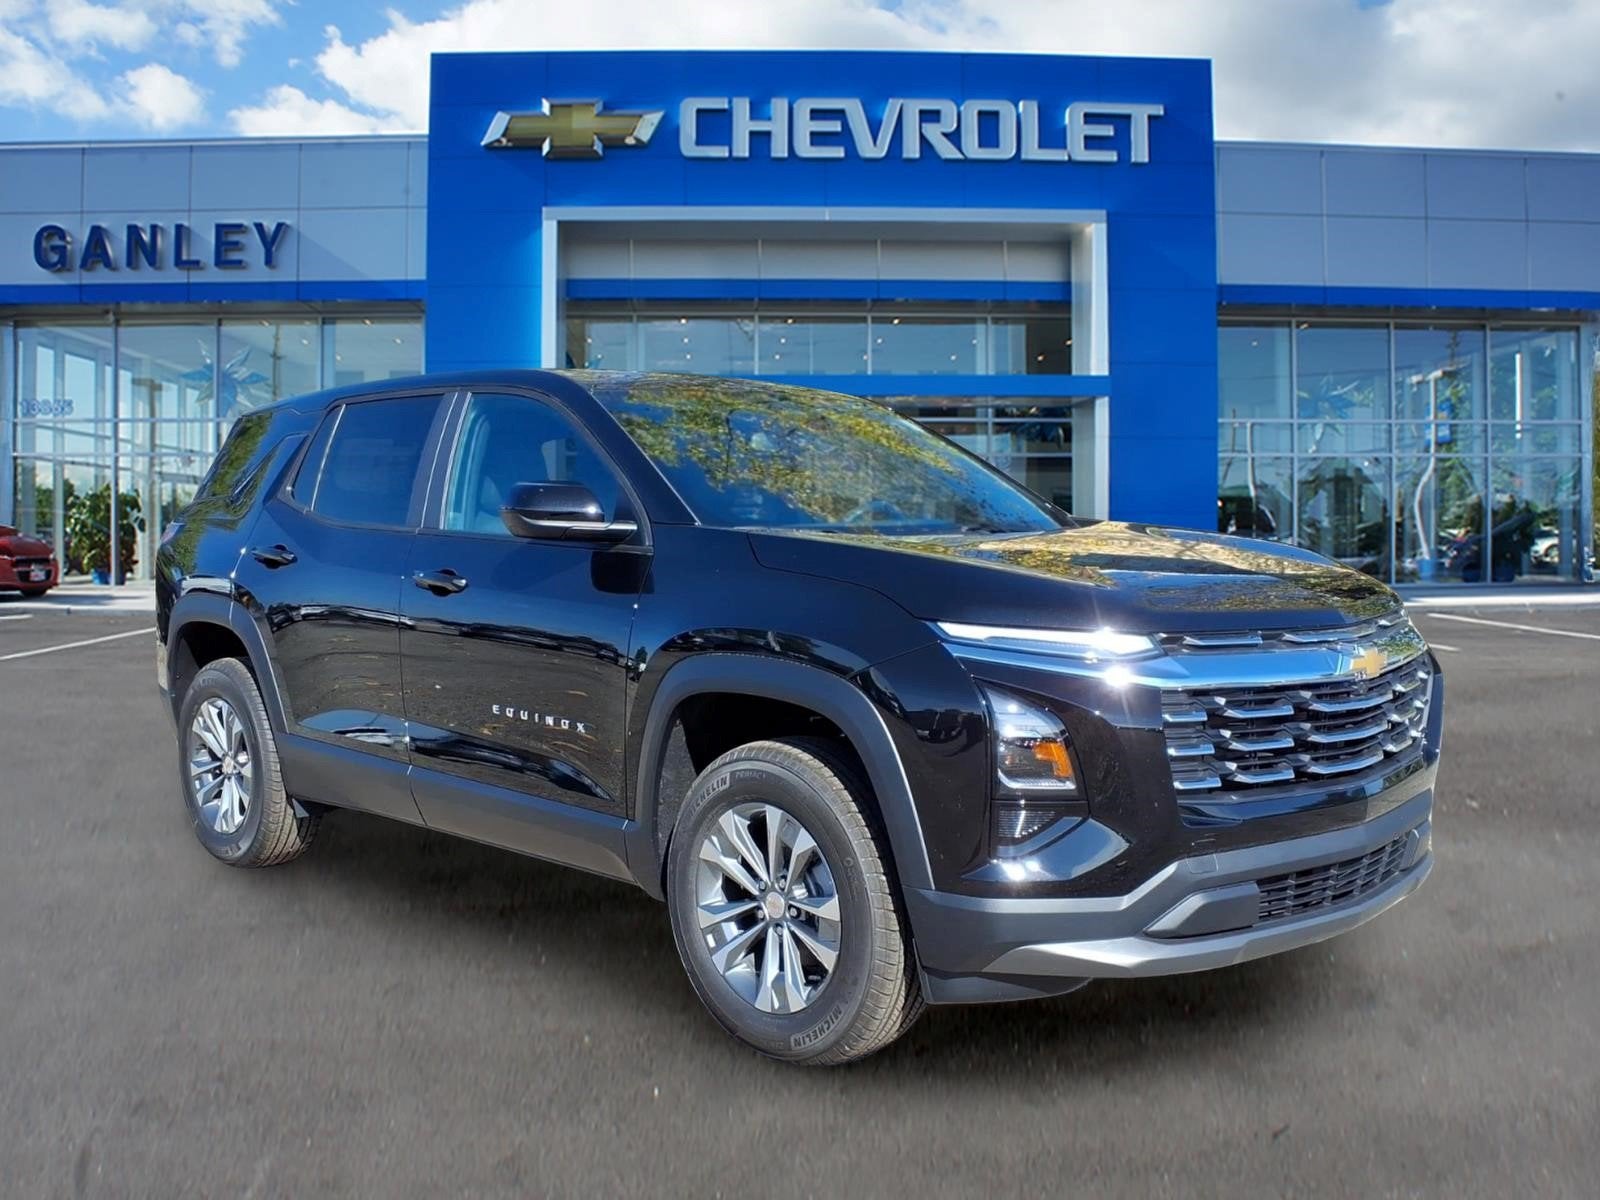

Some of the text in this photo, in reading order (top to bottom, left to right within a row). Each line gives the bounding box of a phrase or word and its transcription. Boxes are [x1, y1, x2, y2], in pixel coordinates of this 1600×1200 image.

[680, 97, 1164, 163] CHEVROLET
[33, 222, 290, 272] GANLEY
[492, 704, 585, 733] EQUINOX
[792, 1004, 844, 1049] MICHELIN
